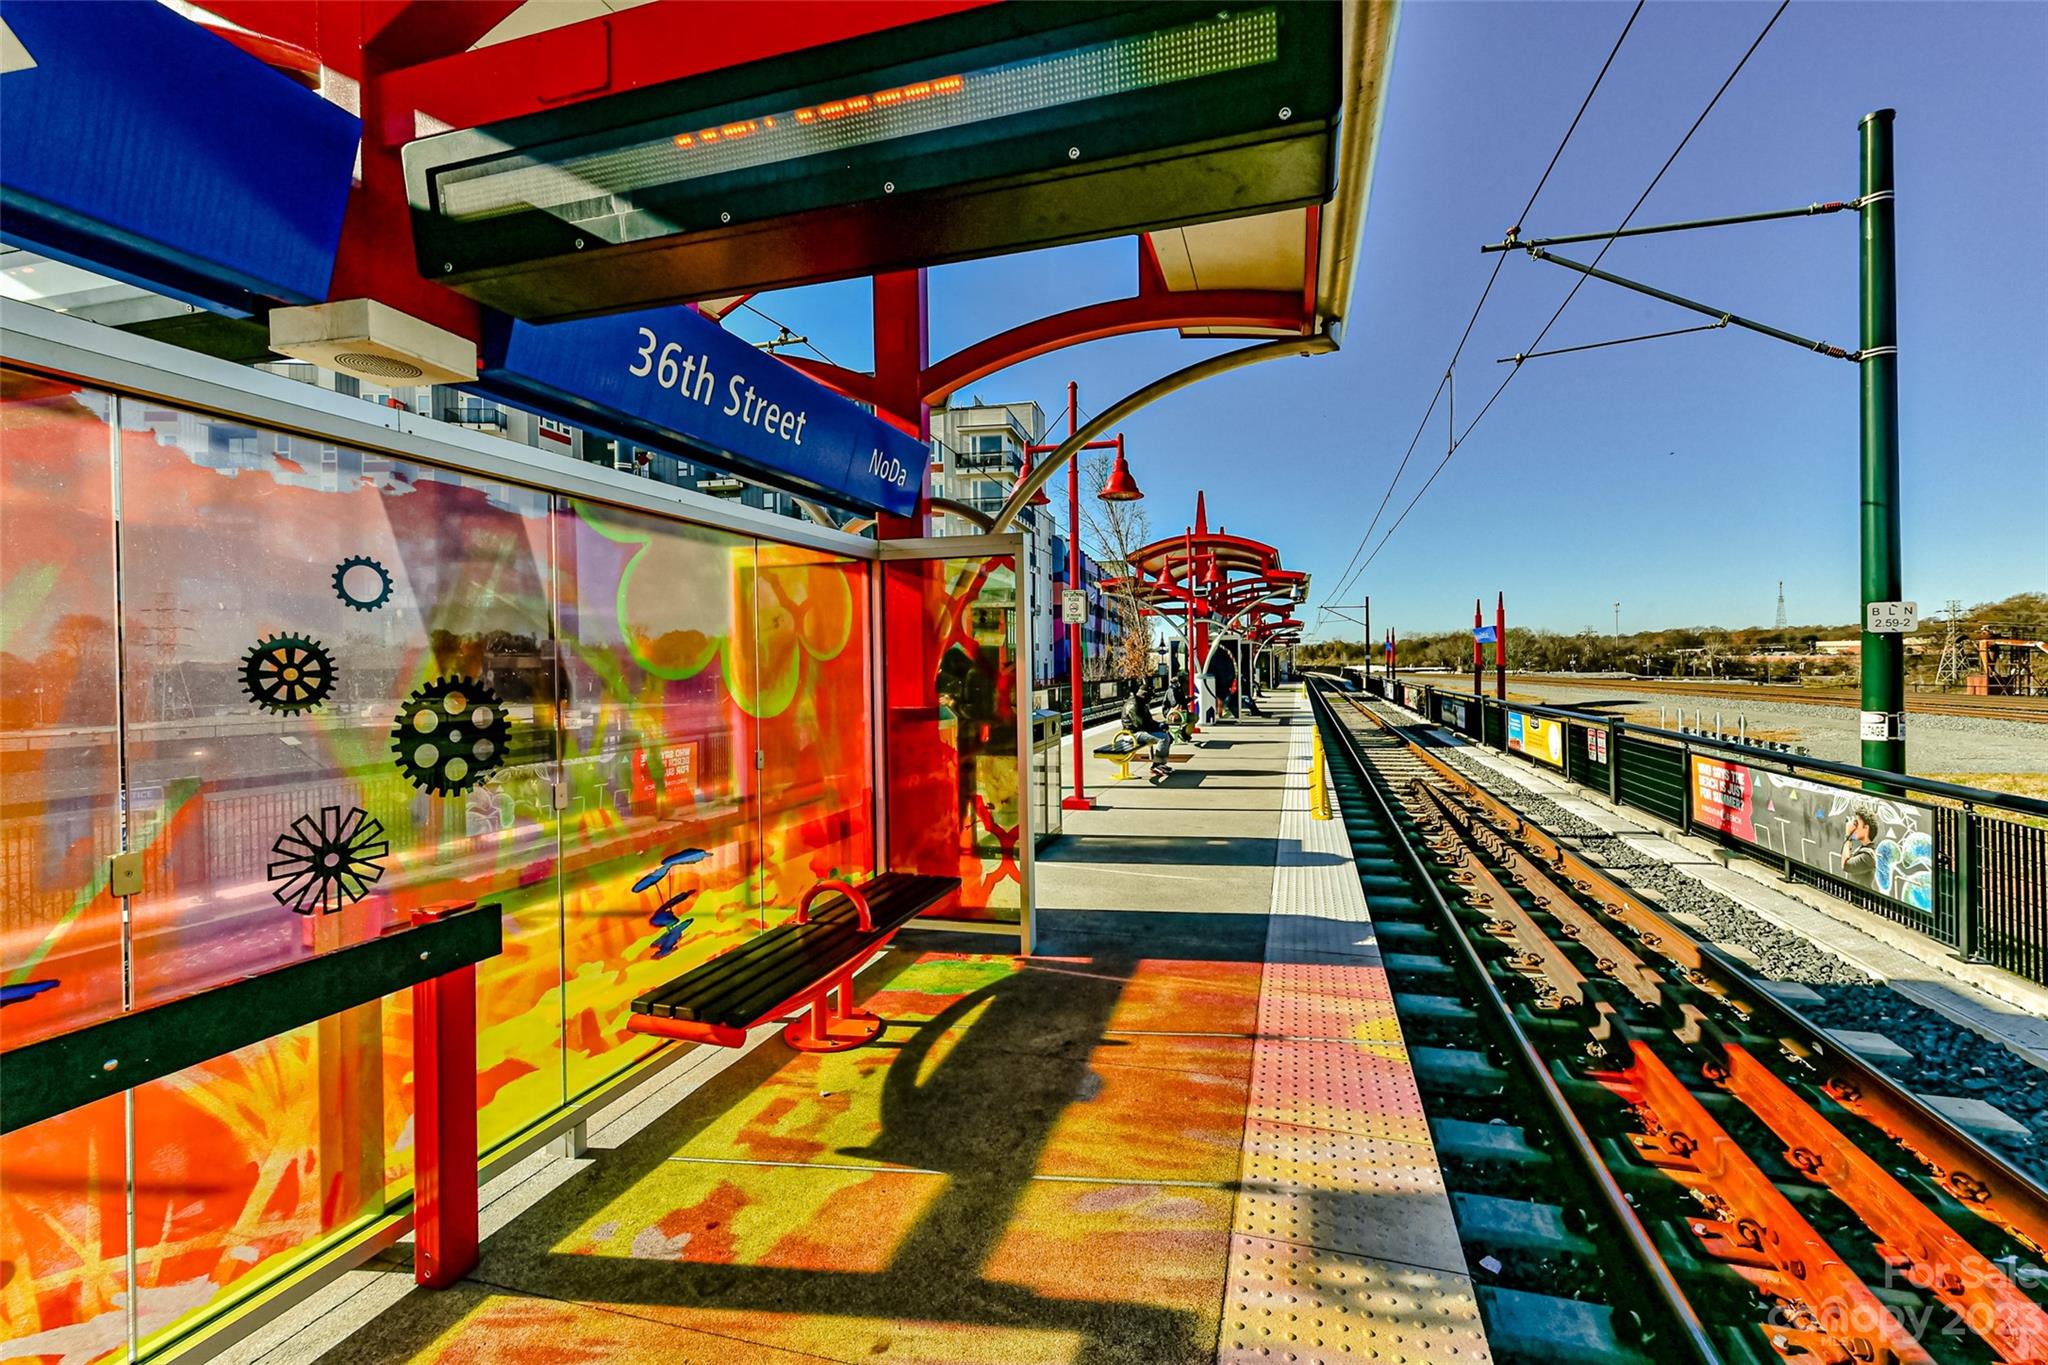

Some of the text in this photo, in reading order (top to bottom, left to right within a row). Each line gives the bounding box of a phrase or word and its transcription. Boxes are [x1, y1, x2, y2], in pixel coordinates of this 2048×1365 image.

[629, 326, 807, 446] 36th Street
[868, 448, 907, 487] NoDa
[1875, 618, 1910, 627] 2.59-2
[1730, 771, 1744, 785] THE
[132, 791, 153, 800] TICE
[1727, 784, 1744, 798] JUST
[1712, 791, 1744, 811] SUMMER?
